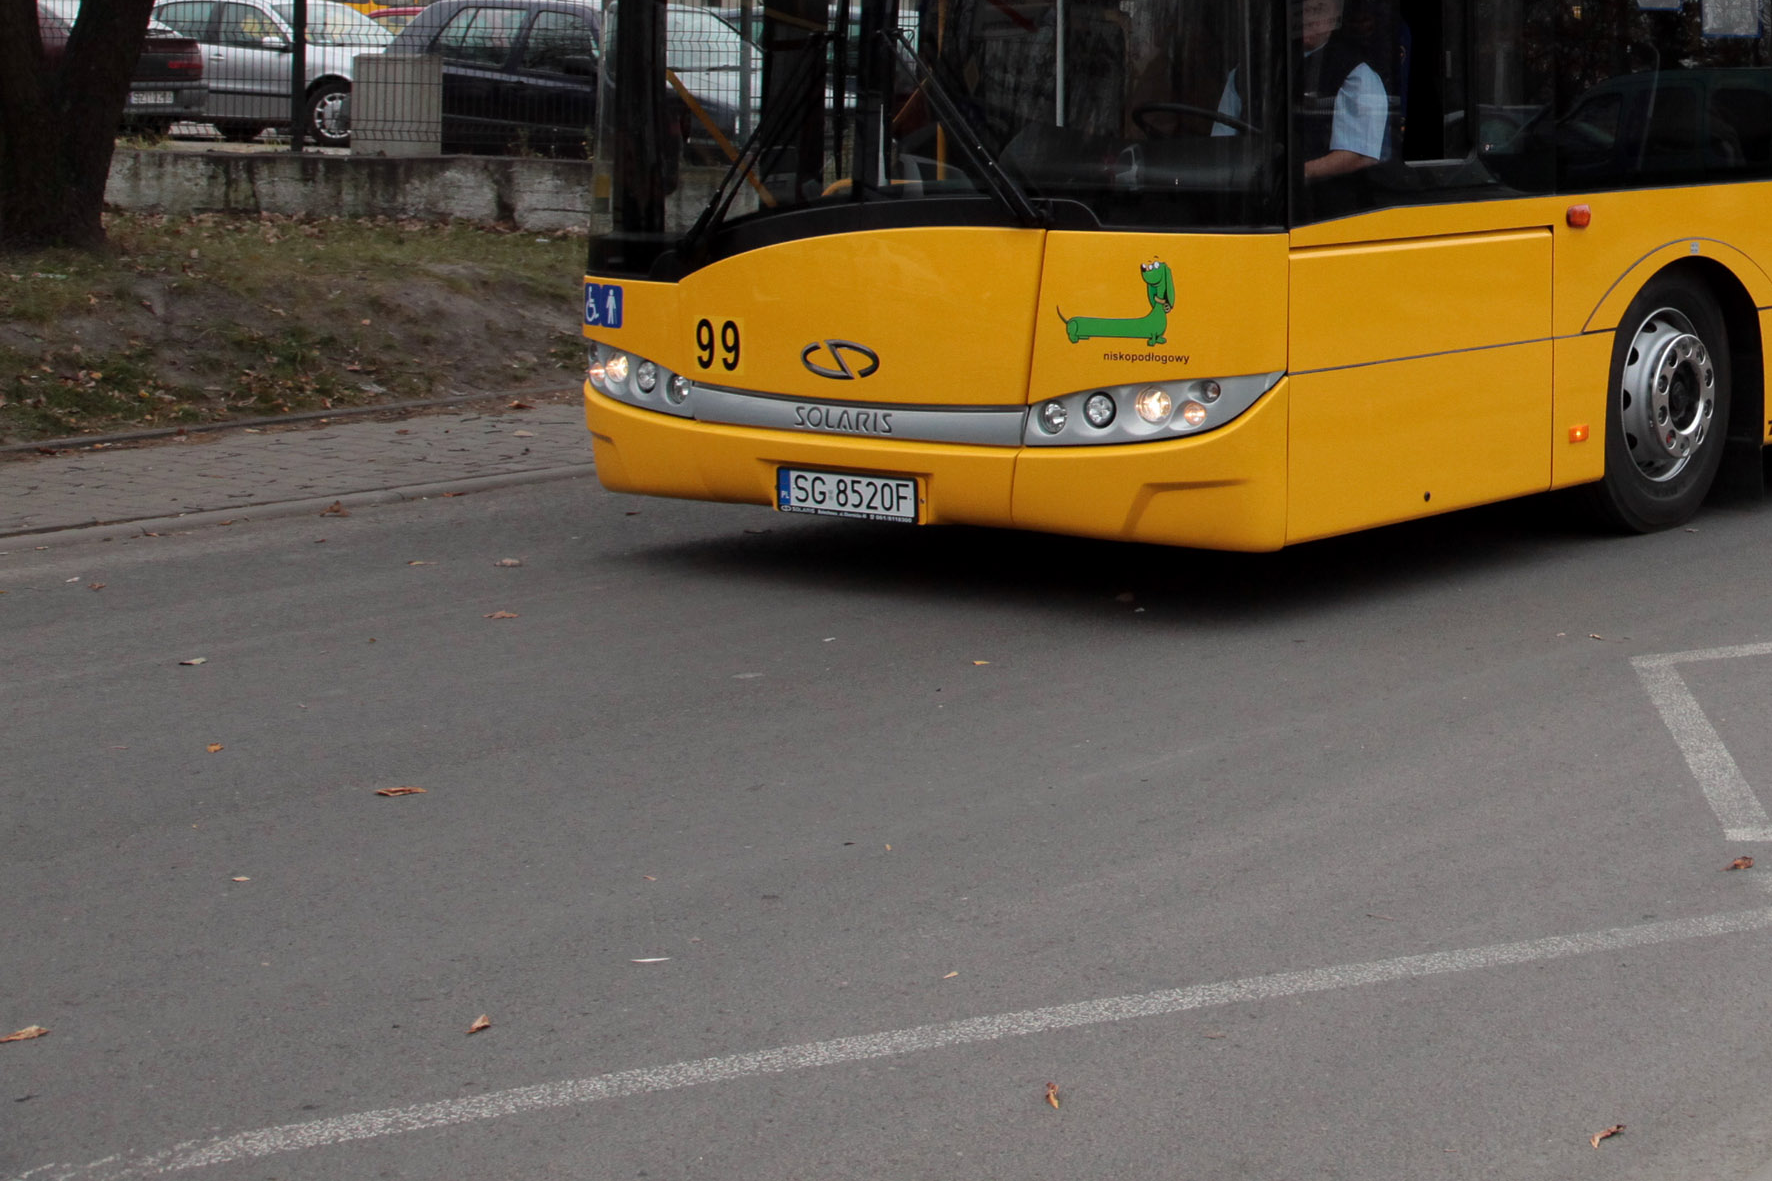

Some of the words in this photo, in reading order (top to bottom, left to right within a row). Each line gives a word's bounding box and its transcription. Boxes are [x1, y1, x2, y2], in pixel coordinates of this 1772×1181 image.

[696, 318, 741, 371] 99
[1103, 351, 1190, 365] niskopodłogowy
[794, 406, 893, 434] SOLARIS
[780, 490, 790, 500] PL
[794, 474, 827, 505] SG
[835, 478, 910, 513] 8520F
